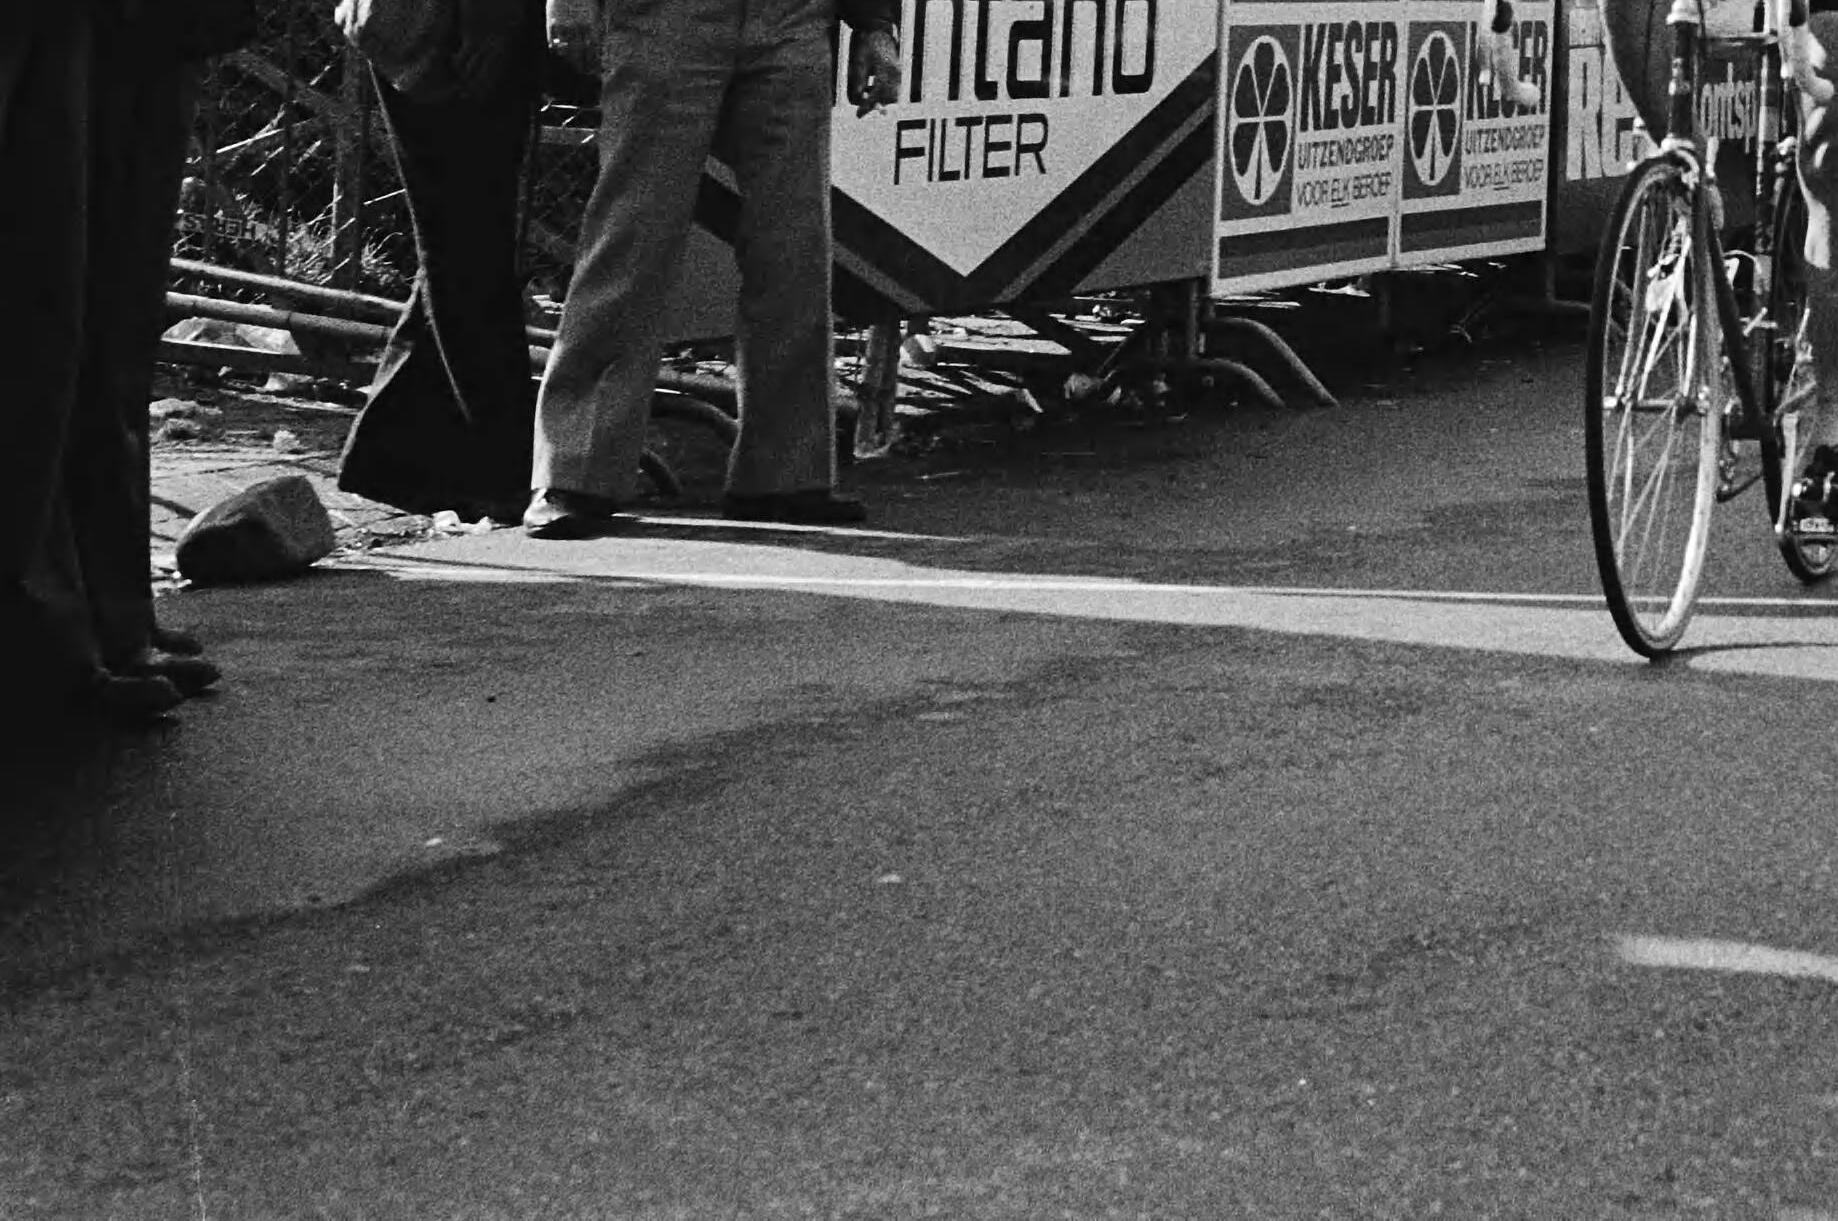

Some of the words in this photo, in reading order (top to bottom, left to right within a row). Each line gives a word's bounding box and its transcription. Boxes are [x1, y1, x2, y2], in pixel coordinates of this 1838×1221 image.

[1300, 19, 1398, 132] KESER
[894, 113, 1049, 185] FILTER
[1298, 134, 1395, 170] UITZENDGROEP
